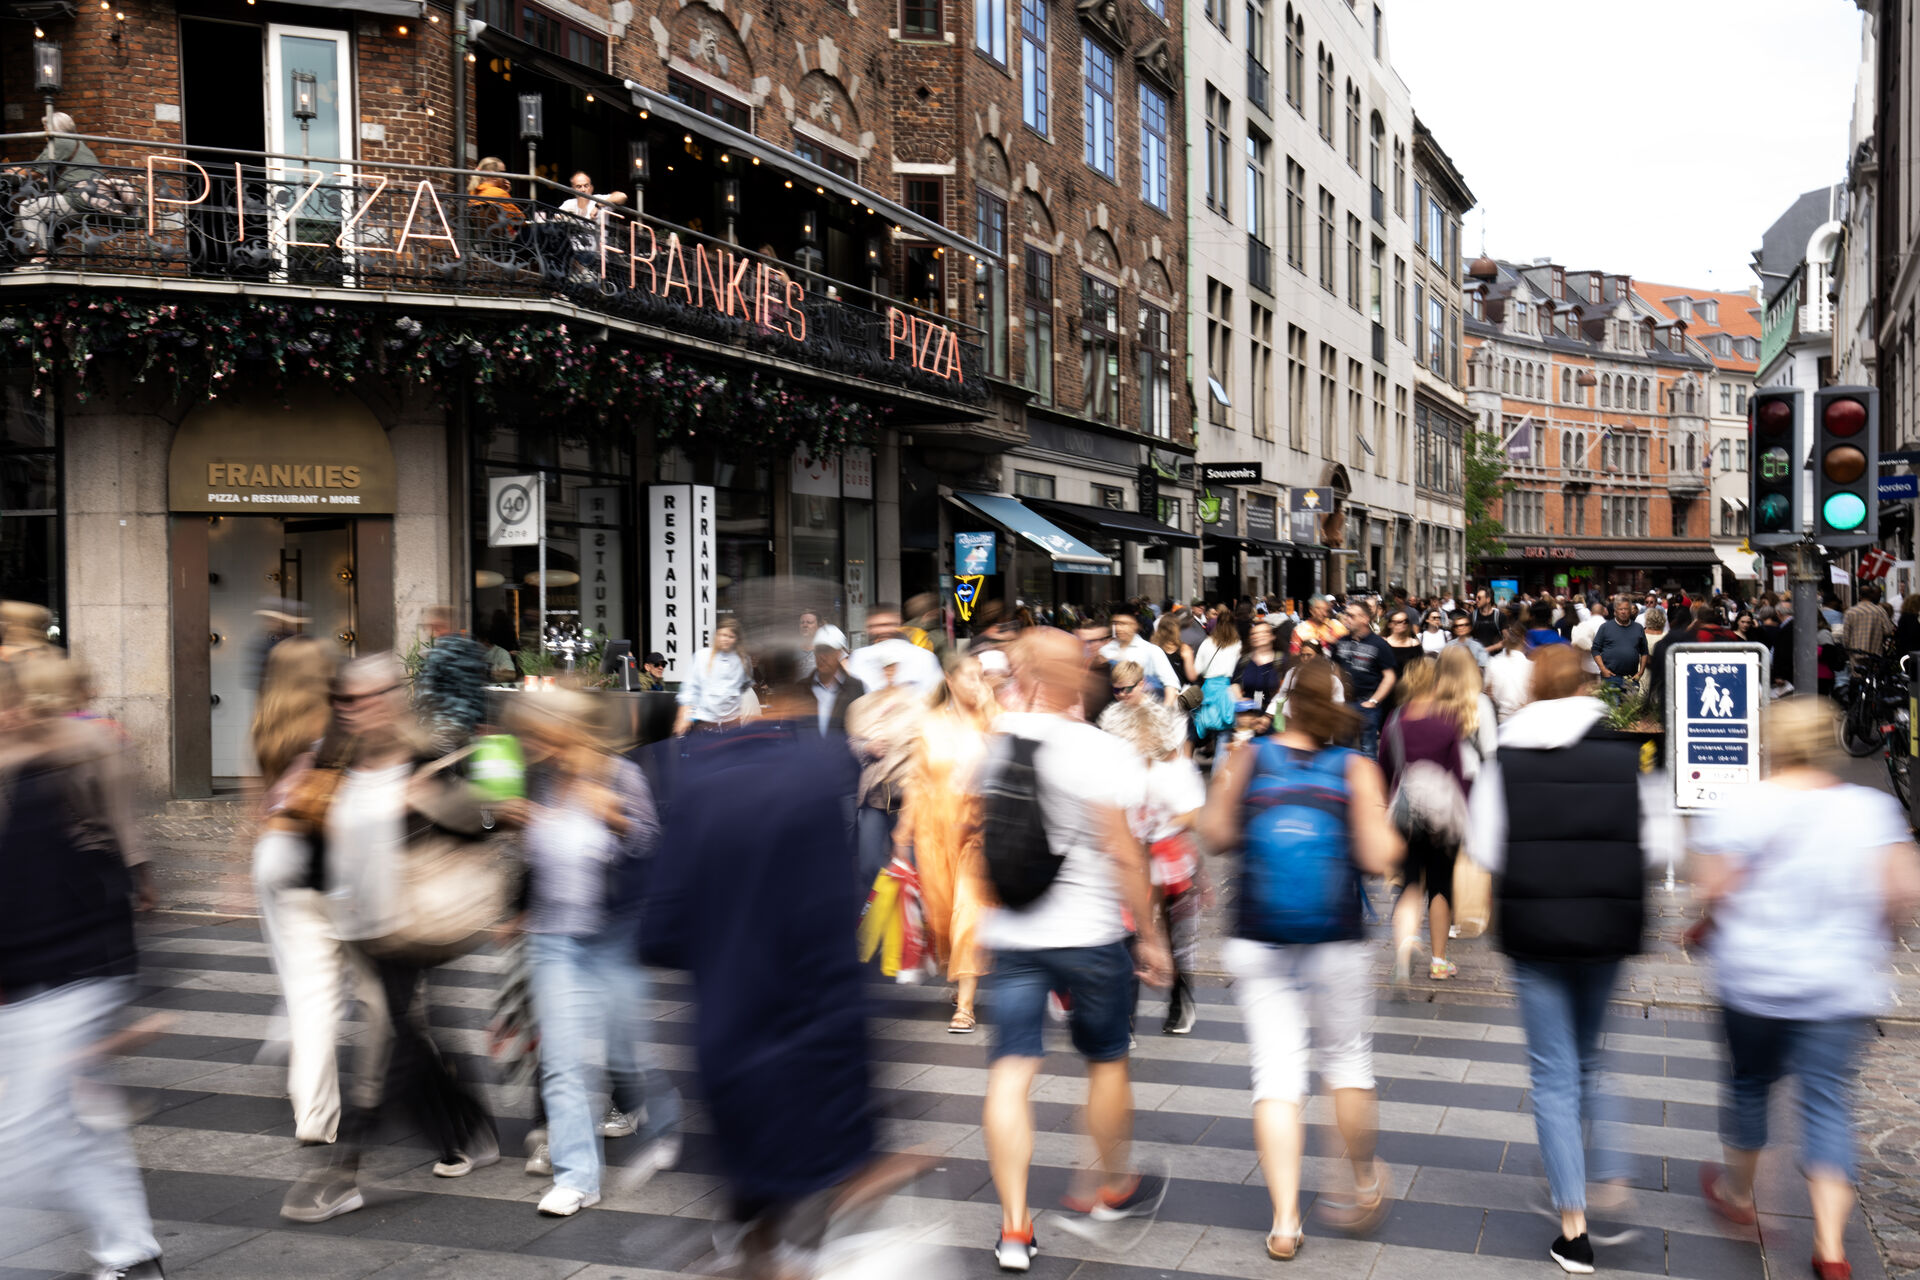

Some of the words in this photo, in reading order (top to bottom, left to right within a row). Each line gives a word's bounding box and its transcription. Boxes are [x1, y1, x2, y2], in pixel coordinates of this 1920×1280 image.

[148, 155, 461, 258] PIZZA
[600, 208, 807, 342] FRANKIES
[888, 306, 964, 384] PIZZA
[207, 463, 362, 489] FRANKIES
[1206, 467, 1257, 480] Souvenirs
[208, 493, 241, 503] PIZZA
[251, 494, 319, 504] RESTAURANT
[329, 495, 361, 505] MORE
[502, 496, 524, 513] 40
[1141, 474, 1154, 515] NICO
[501, 528, 528, 538] Zone
[664, 495, 677, 671] RESTAURANT
[700, 495, 709, 648] FRANKIE
